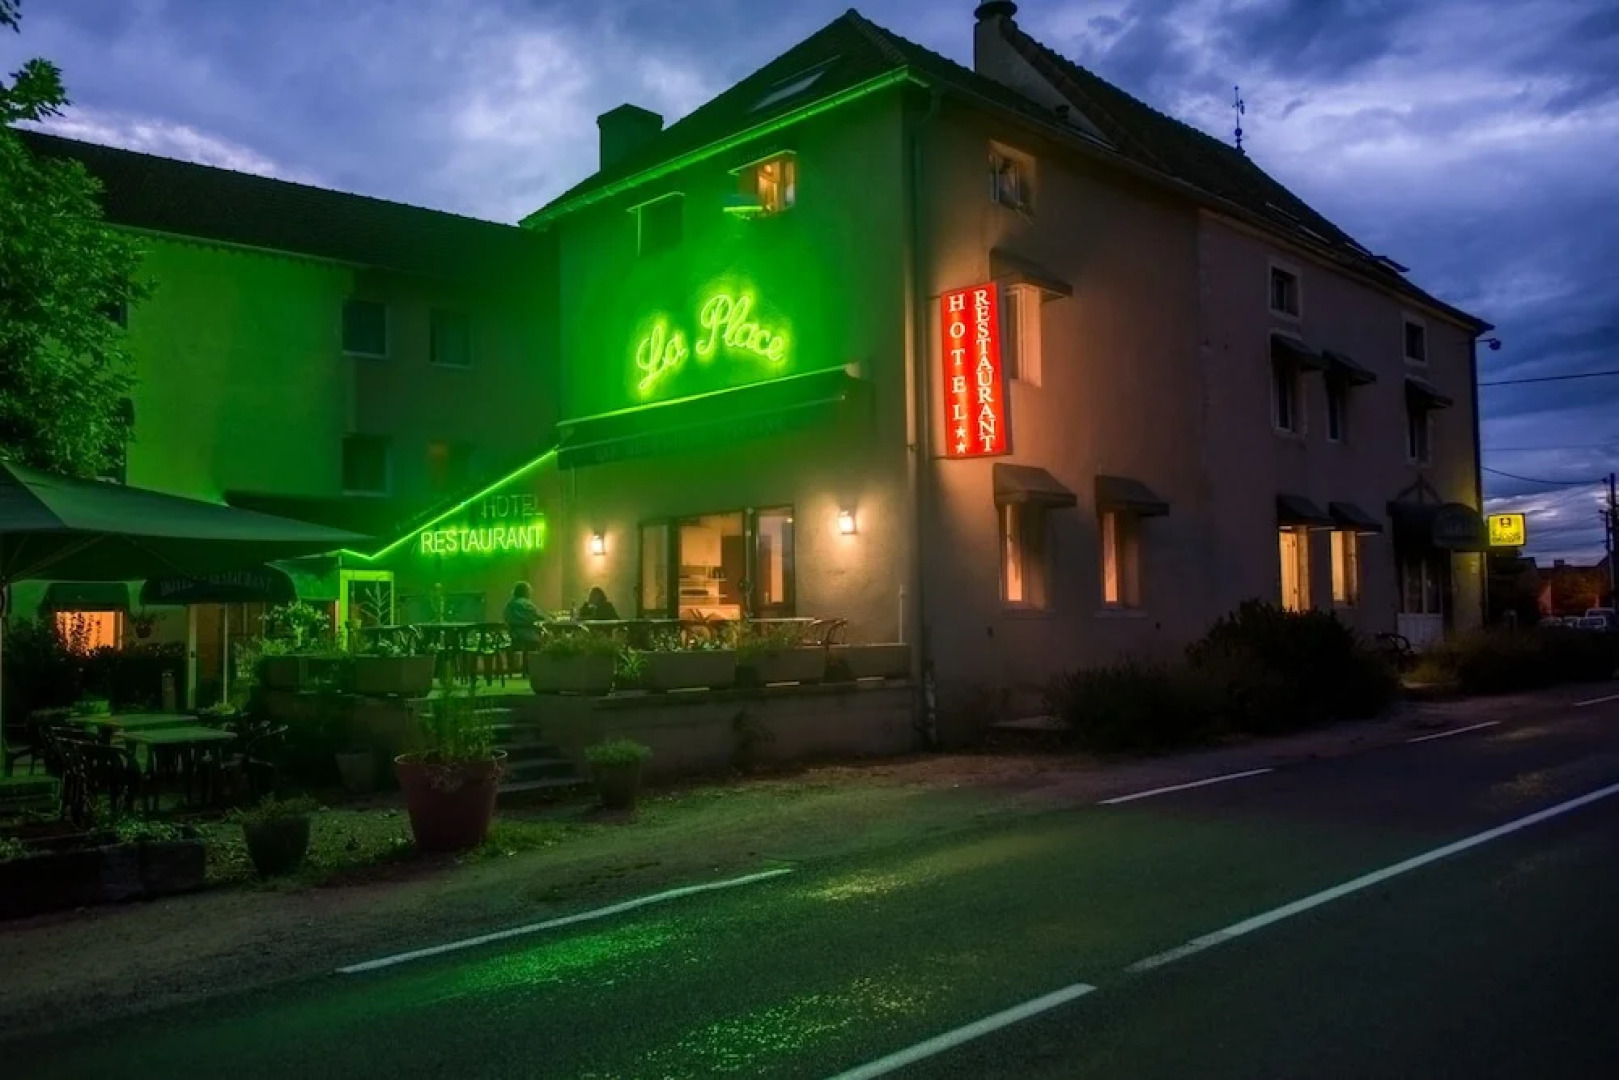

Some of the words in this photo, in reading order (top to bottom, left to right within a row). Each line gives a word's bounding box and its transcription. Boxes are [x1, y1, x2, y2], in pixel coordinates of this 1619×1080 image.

[636, 324, 687, 389] La
[696, 294, 784, 362] Place
[949, 293, 966, 420] HOTEL
[974, 290, 996, 452] RESTAURANT
[421, 524, 545, 554] RESTAURANT
[481, 493, 544, 519] HOTEL
